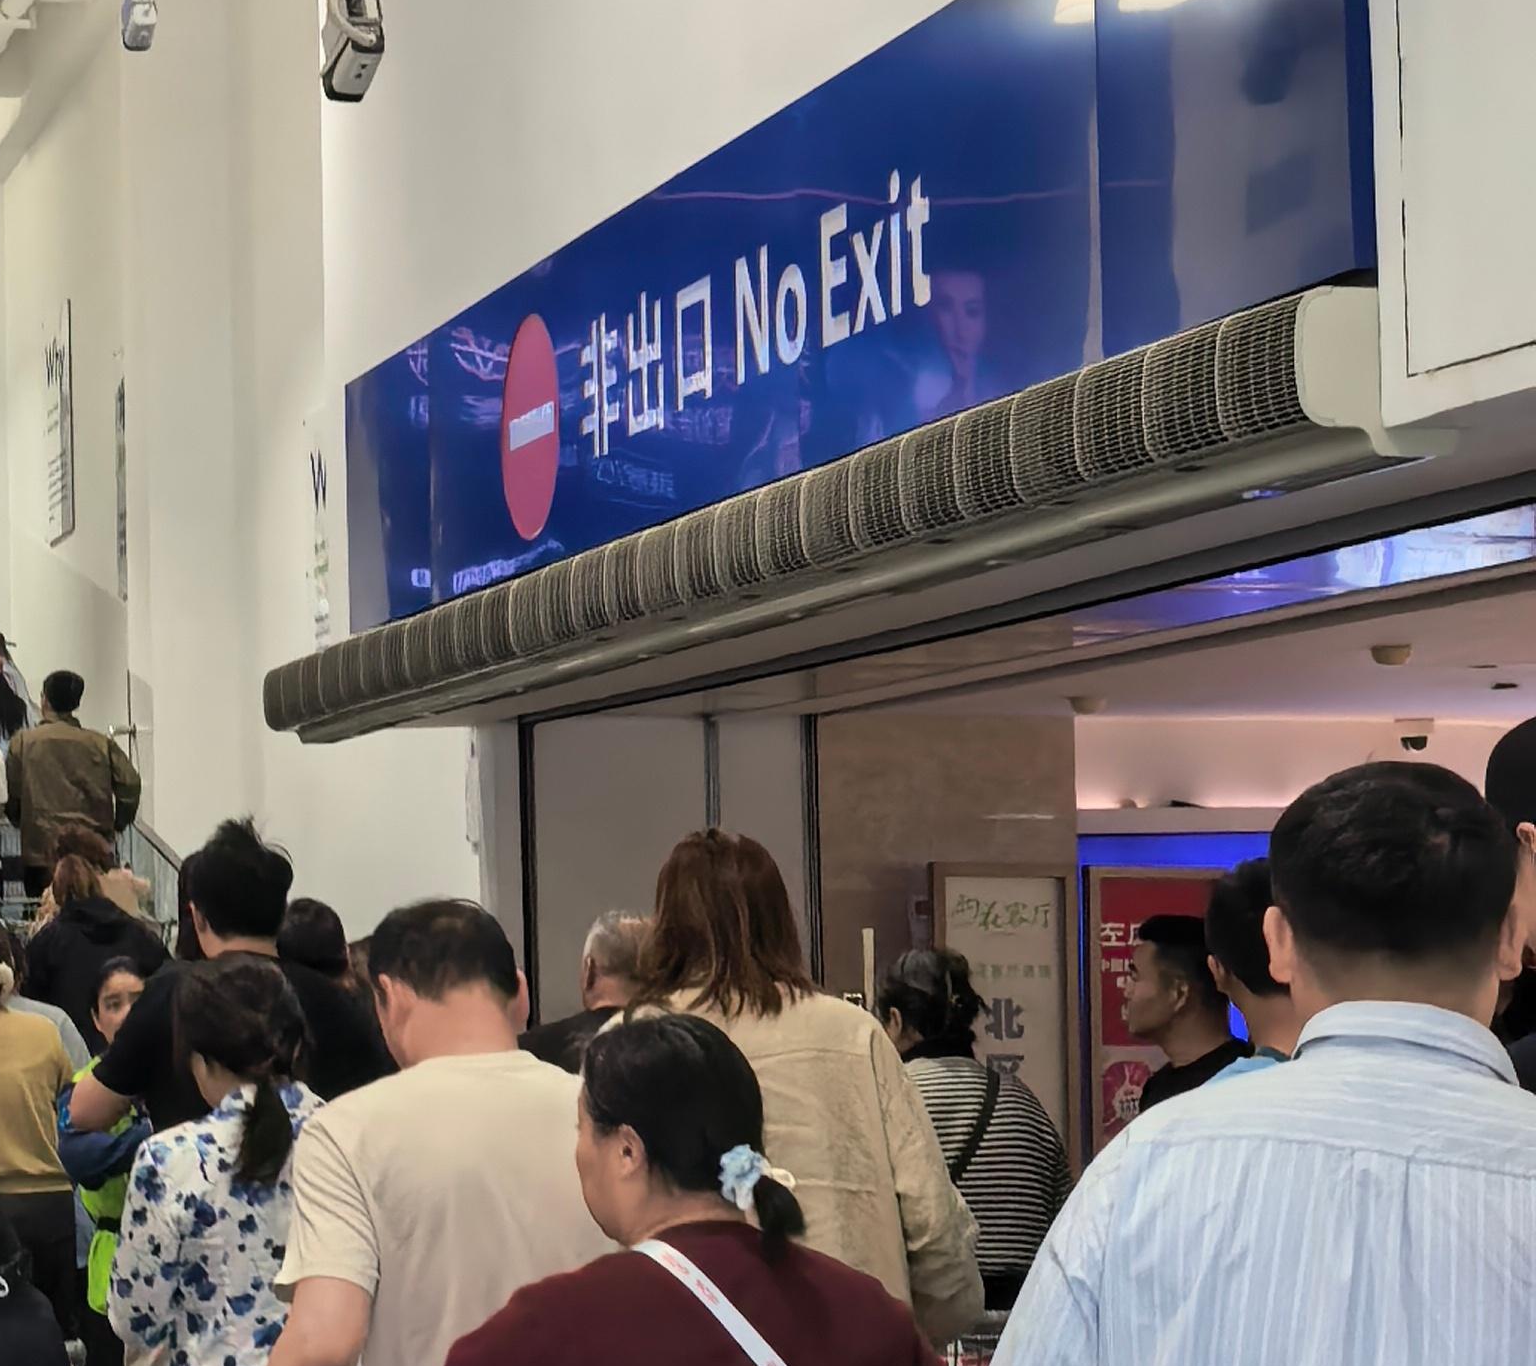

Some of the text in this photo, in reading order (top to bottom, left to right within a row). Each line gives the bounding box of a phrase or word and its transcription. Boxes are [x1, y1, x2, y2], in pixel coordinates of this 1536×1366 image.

[580, 168, 932, 458] 非出口 No Exit
